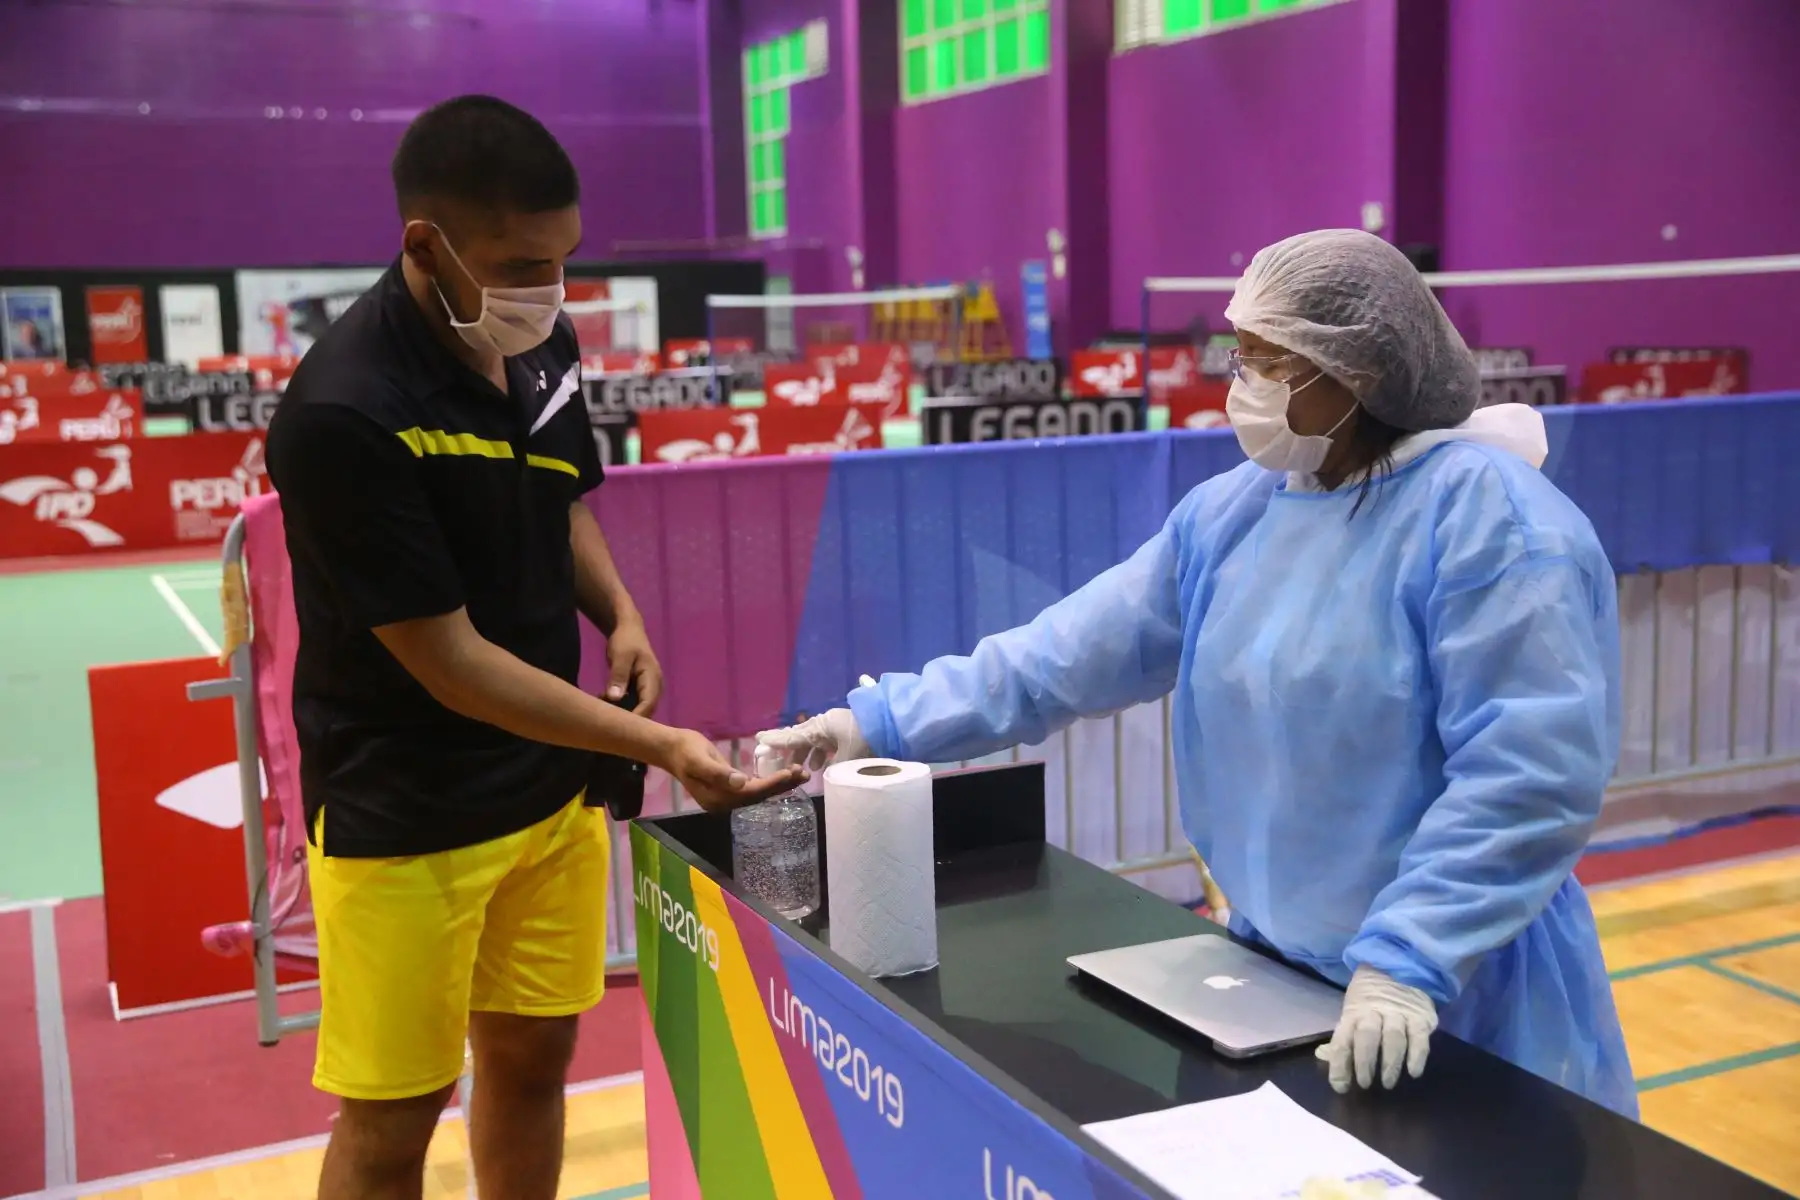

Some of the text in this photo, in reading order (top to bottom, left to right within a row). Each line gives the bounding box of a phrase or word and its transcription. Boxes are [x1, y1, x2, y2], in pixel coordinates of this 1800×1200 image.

[200, 394, 277, 432] LEG
[582, 376, 722, 412] LEGADO
[634, 869, 720, 972] ima2019
